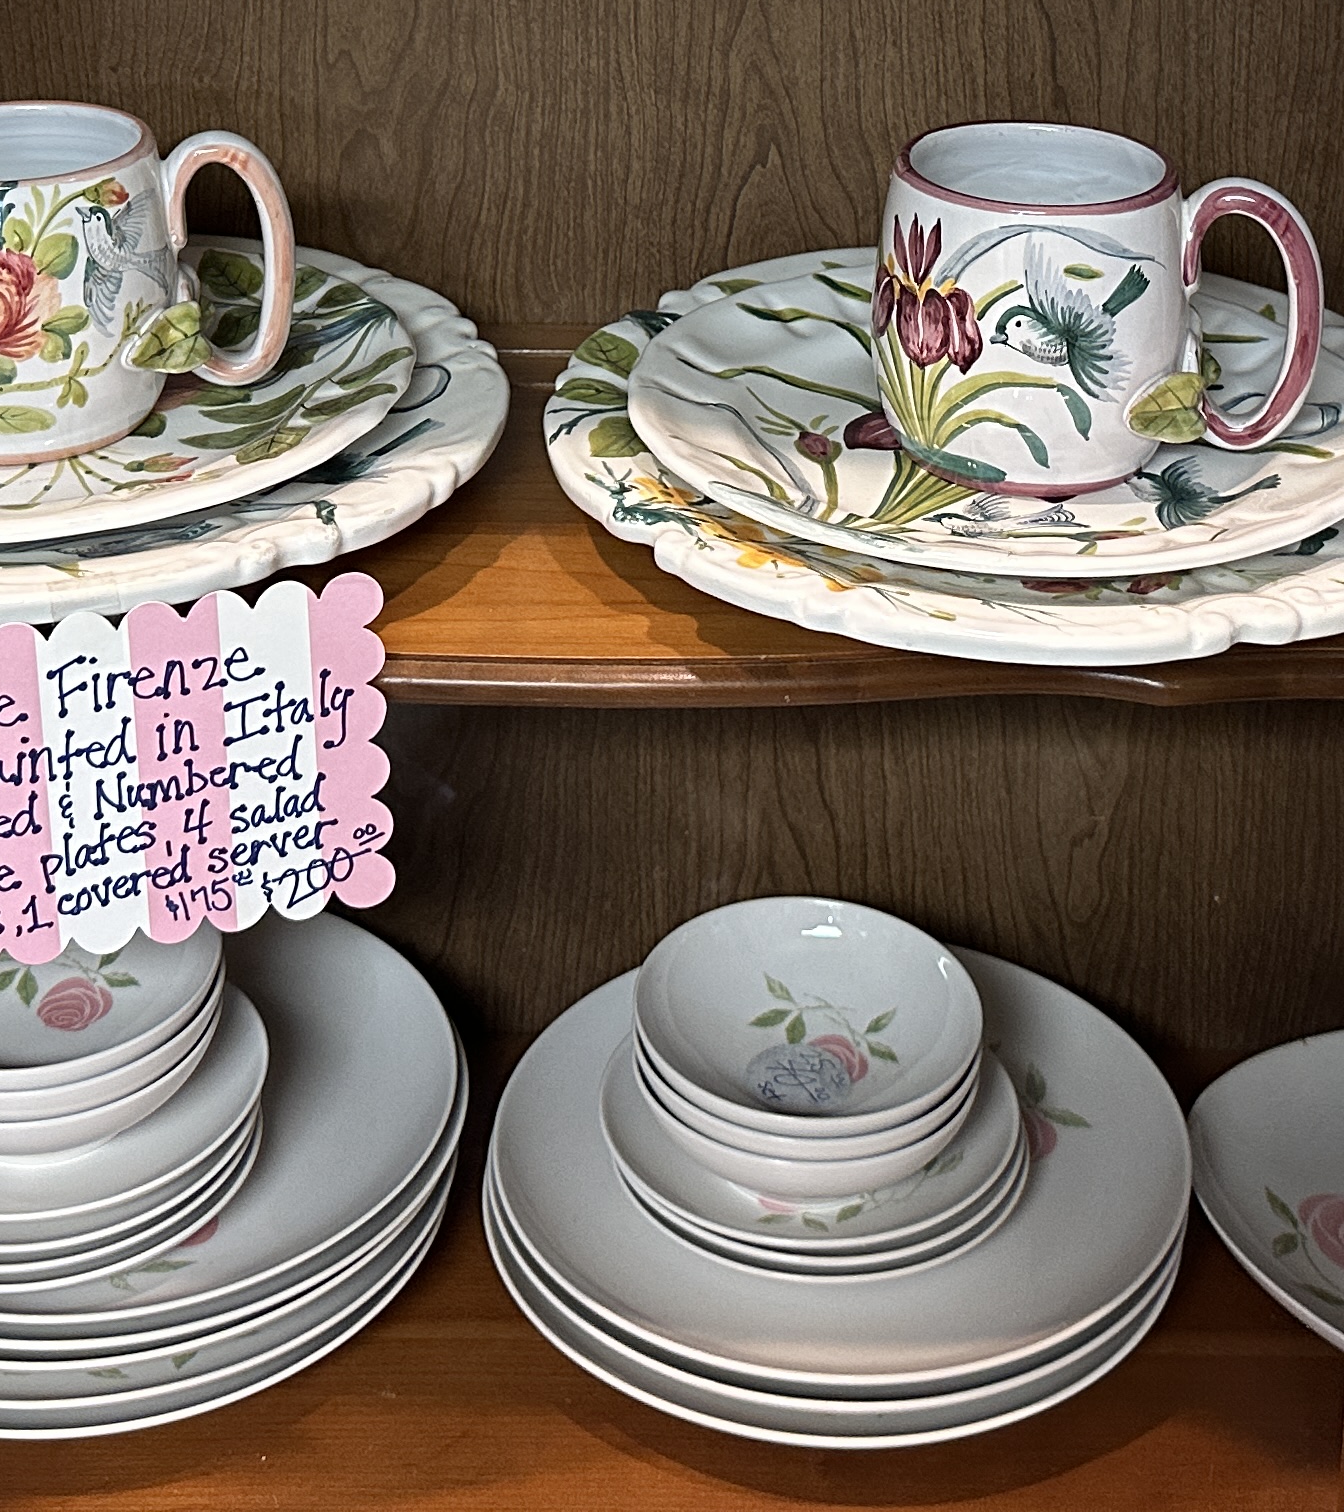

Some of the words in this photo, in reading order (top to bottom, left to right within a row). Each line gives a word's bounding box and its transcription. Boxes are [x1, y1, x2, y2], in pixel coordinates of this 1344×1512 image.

[47, 644, 266, 718] Firenze
[156, 712, 200, 761] in
[222, 669, 355, 750] Italy
[58, 780, 76, 829] &
[93, 734, 304, 821] Numbered
[183, 799, 213, 845] 4
[229, 771, 327, 835] salad
[57, 843, 193, 916] covered
[207, 818, 339, 874] server
